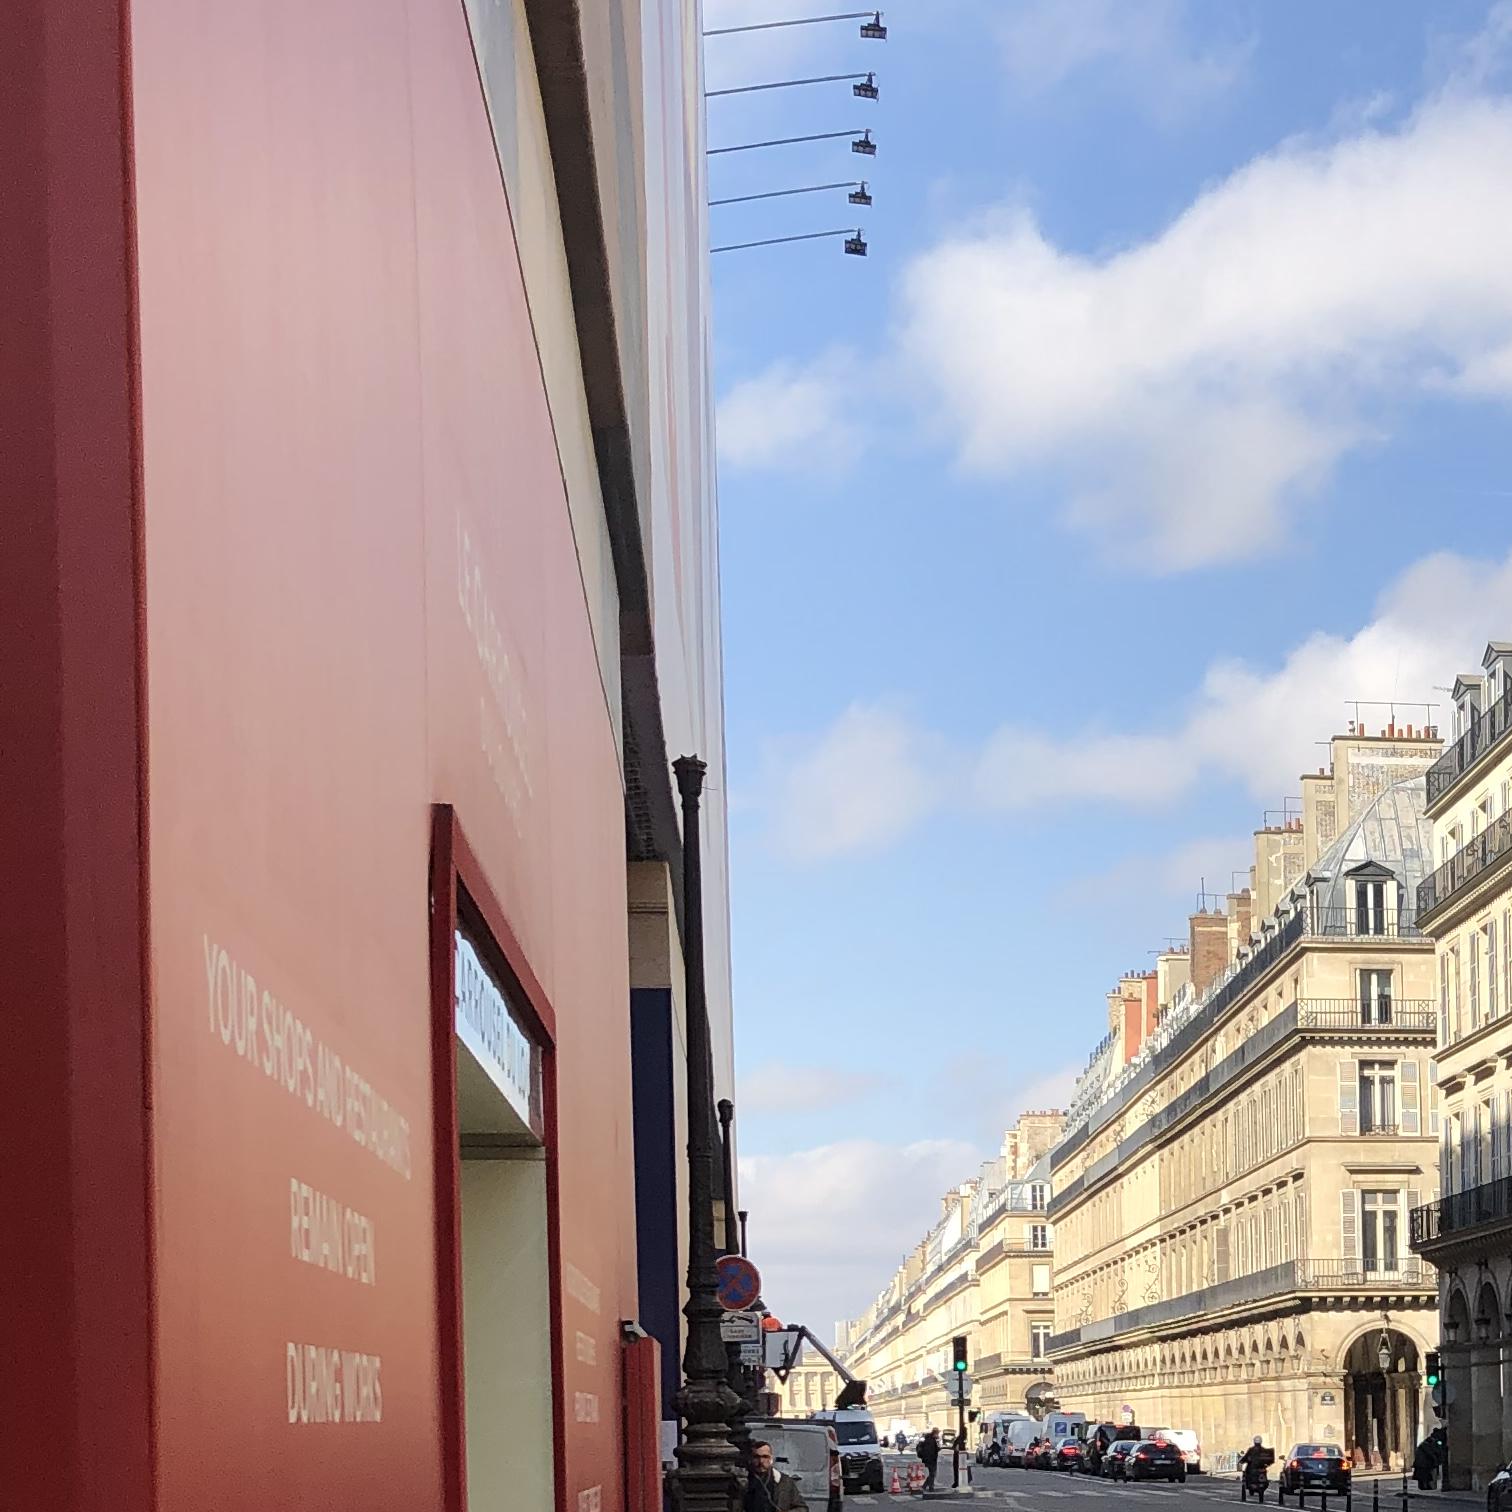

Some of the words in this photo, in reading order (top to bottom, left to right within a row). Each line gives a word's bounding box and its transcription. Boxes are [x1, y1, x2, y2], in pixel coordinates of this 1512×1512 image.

[203, 933, 258, 1067] YOUR
[262, 990, 315, 1108] SHOPS
[316, 1041, 343, 1128] AND
